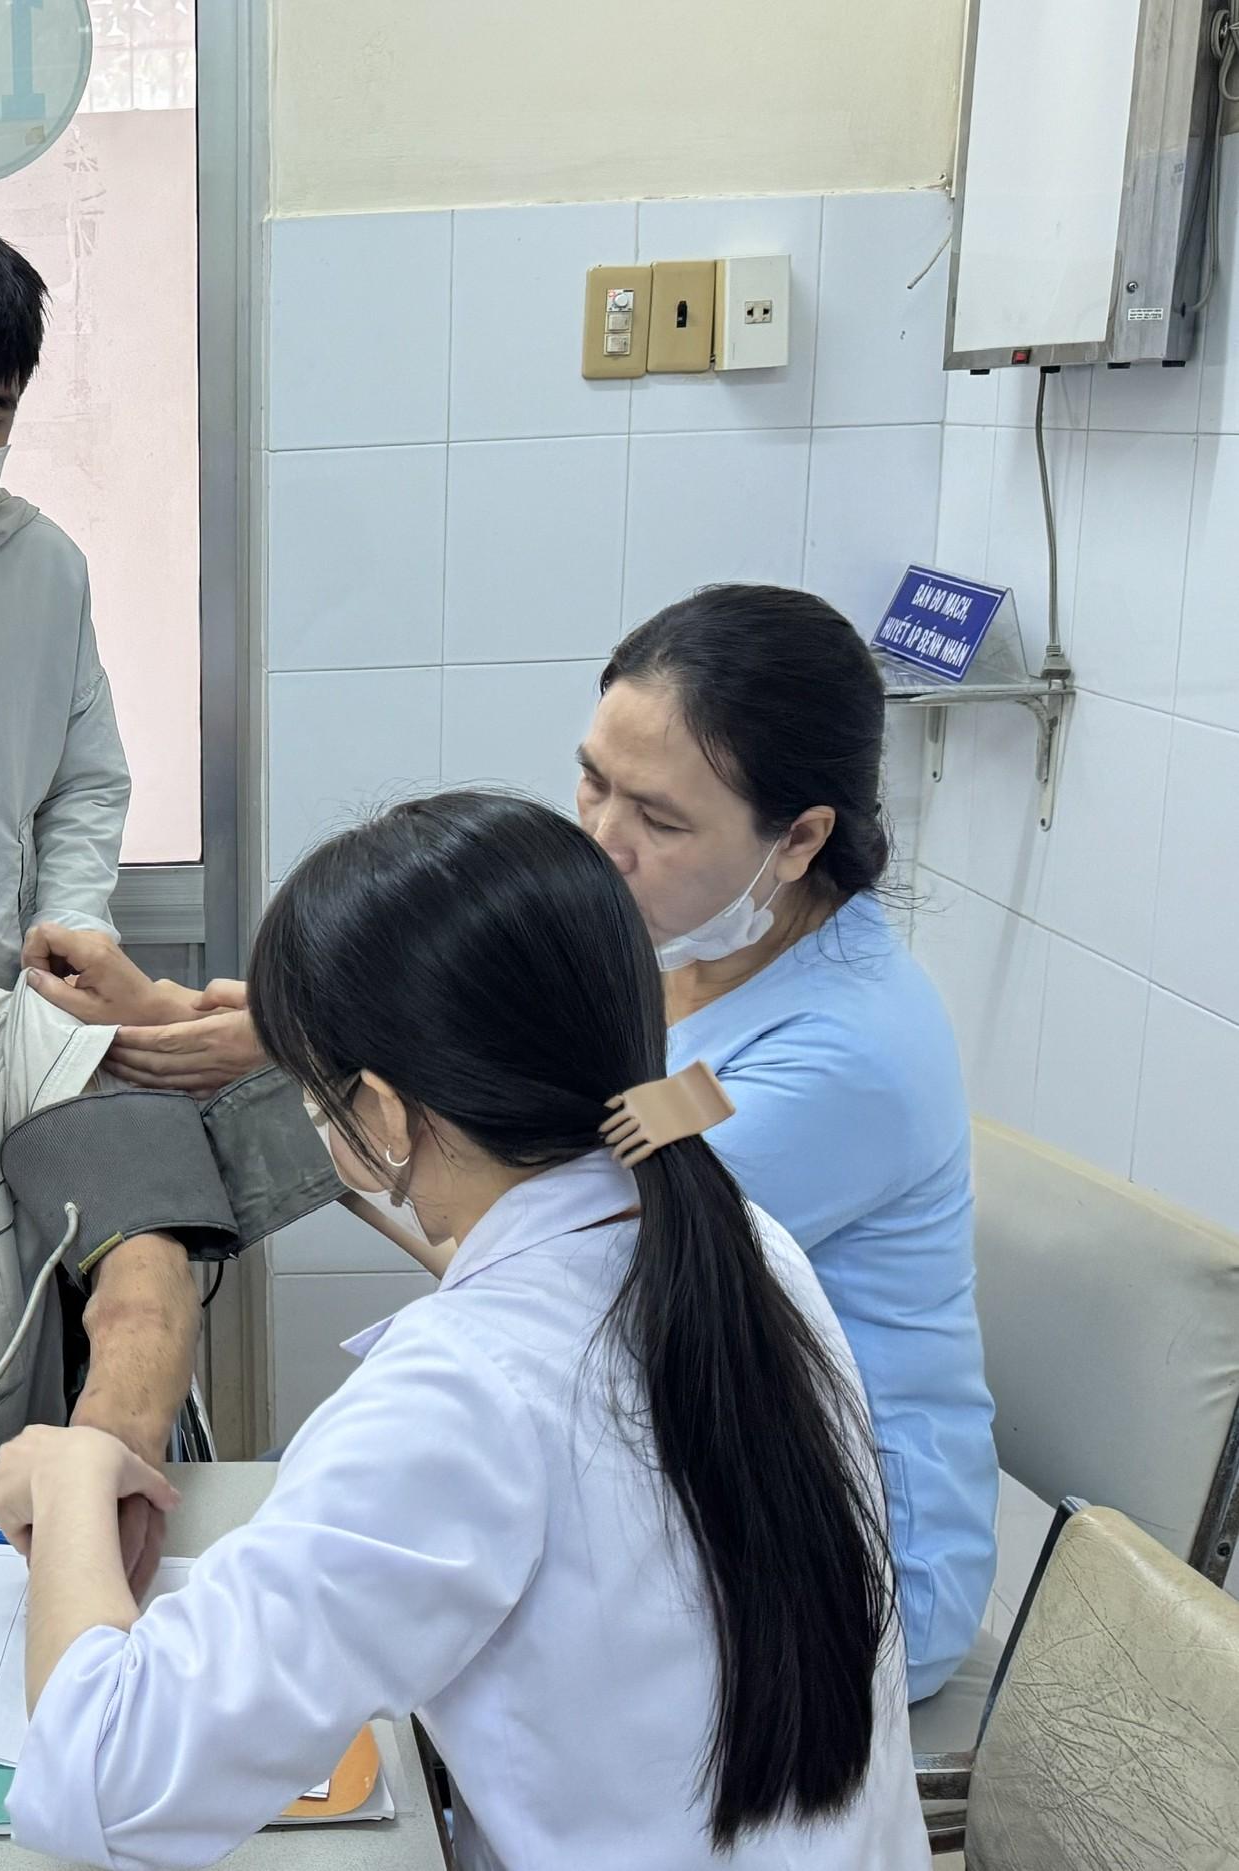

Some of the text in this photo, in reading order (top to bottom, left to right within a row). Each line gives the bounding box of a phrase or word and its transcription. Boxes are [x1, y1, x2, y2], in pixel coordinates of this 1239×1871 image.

[880, 614, 971, 668] HUYẾT ÁP BỆNH NHÂN
